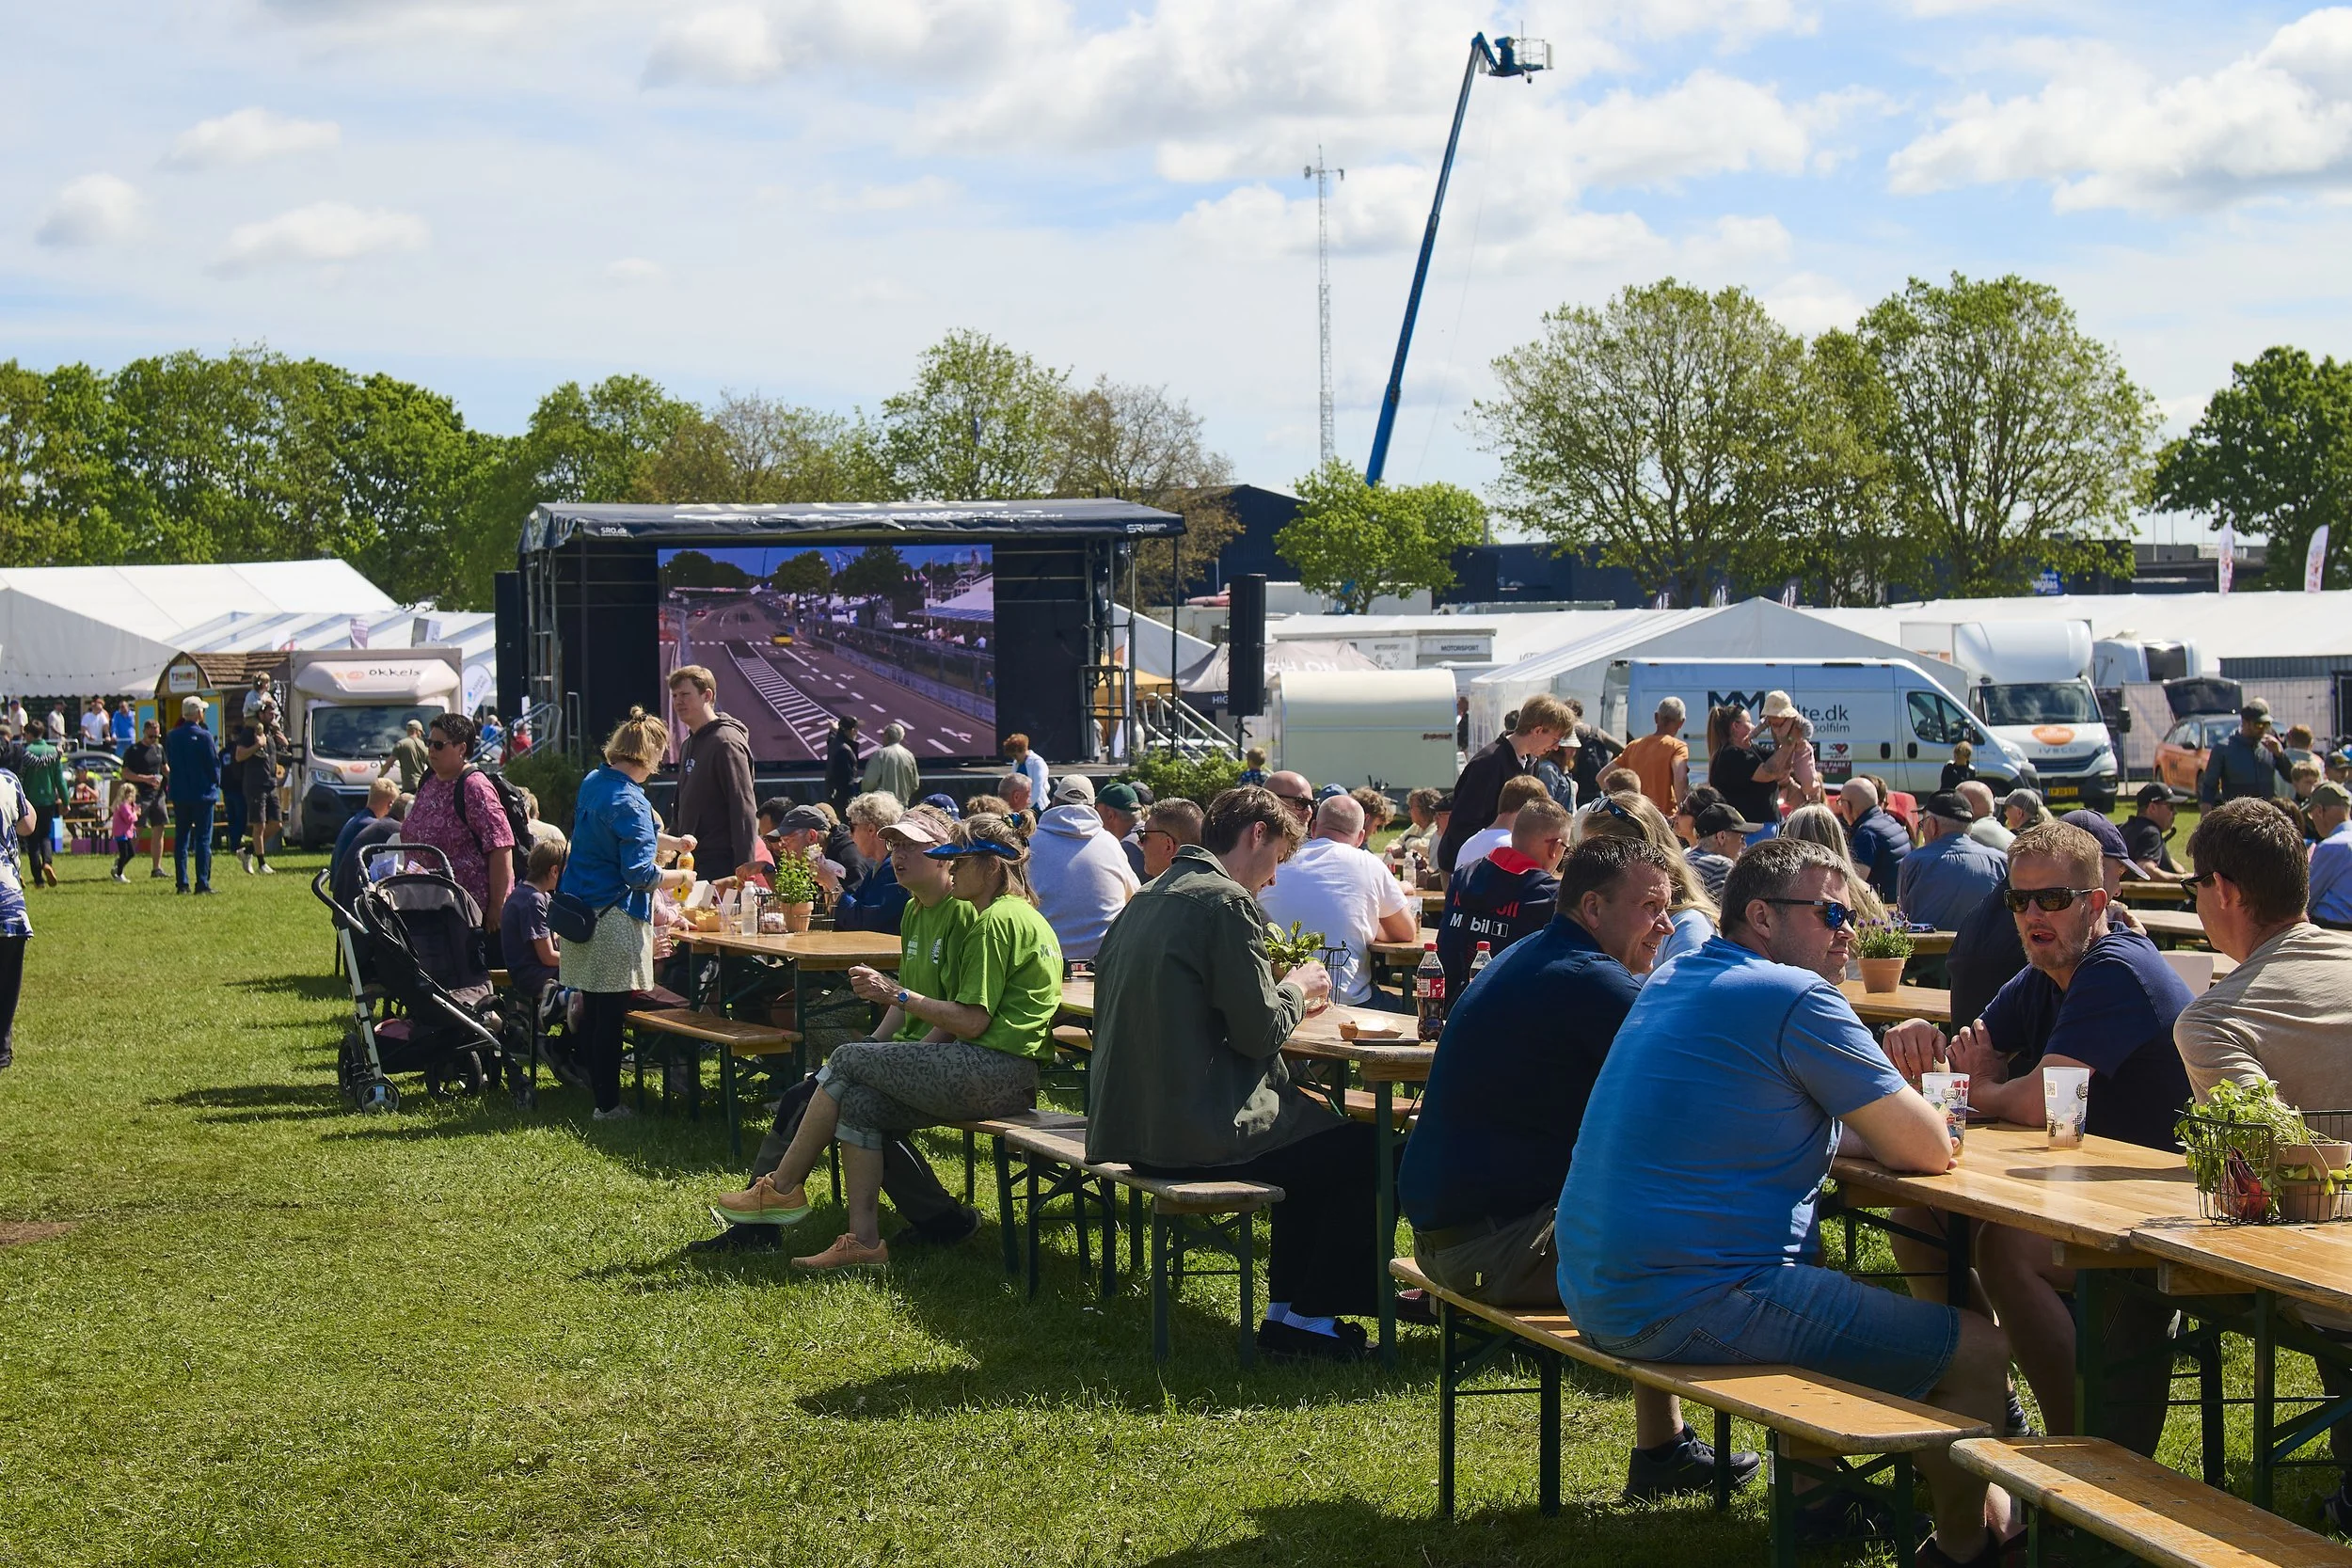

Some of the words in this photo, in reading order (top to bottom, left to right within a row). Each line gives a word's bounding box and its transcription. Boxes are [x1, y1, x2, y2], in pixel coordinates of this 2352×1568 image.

[369, 668, 421, 677] okkels
[1212, 695, 1229, 705] HIG
[1796, 704, 1849, 721] lte.dk
[1449, 912, 1490, 934] Mbil
